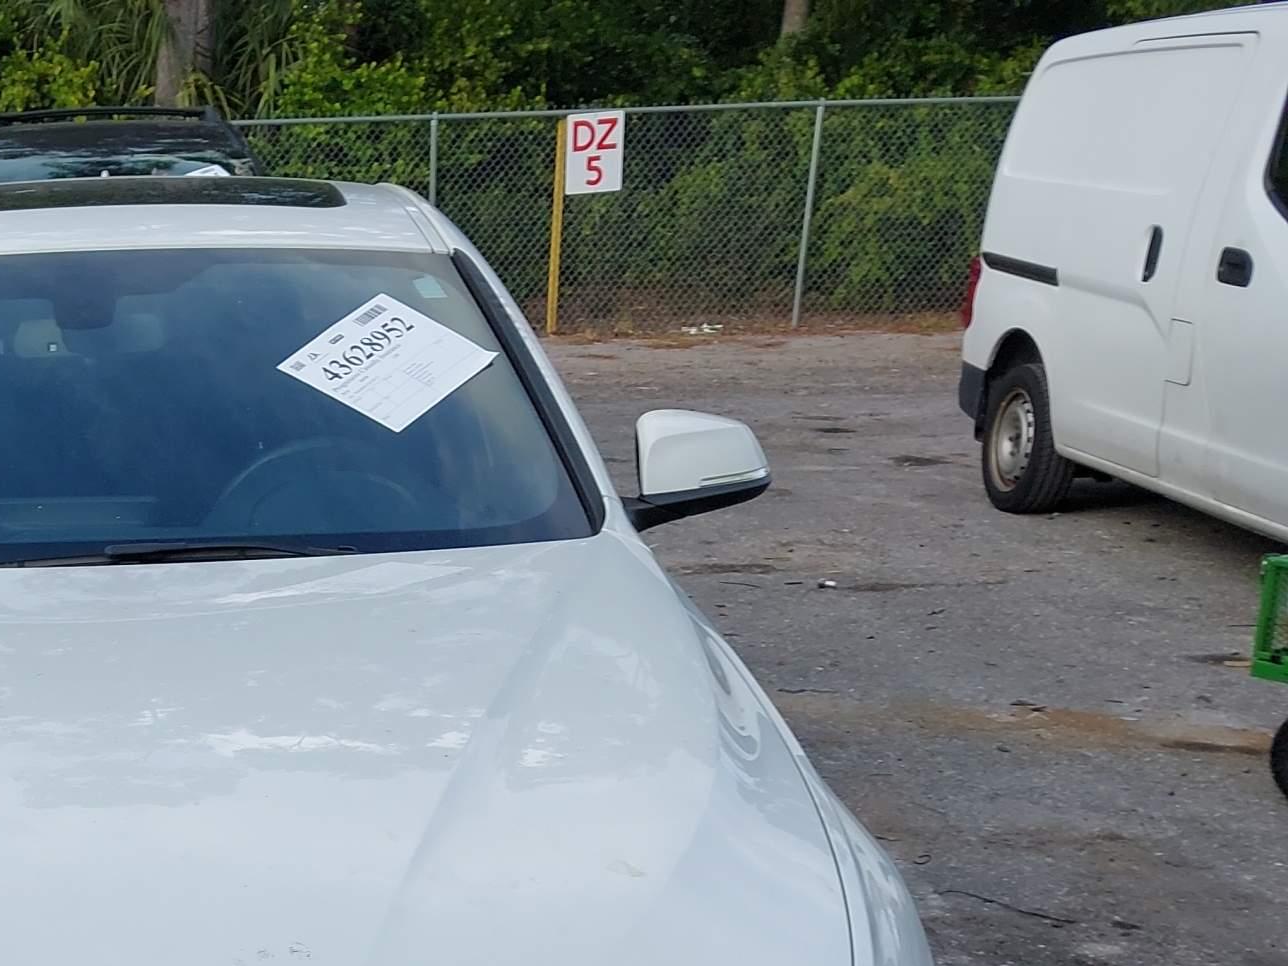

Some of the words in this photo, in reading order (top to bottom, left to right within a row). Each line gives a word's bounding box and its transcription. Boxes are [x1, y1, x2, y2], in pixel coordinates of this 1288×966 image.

[573, 117, 618, 152] DZ
[585, 155, 602, 186] 5
[321, 317, 415, 381] 43628952
